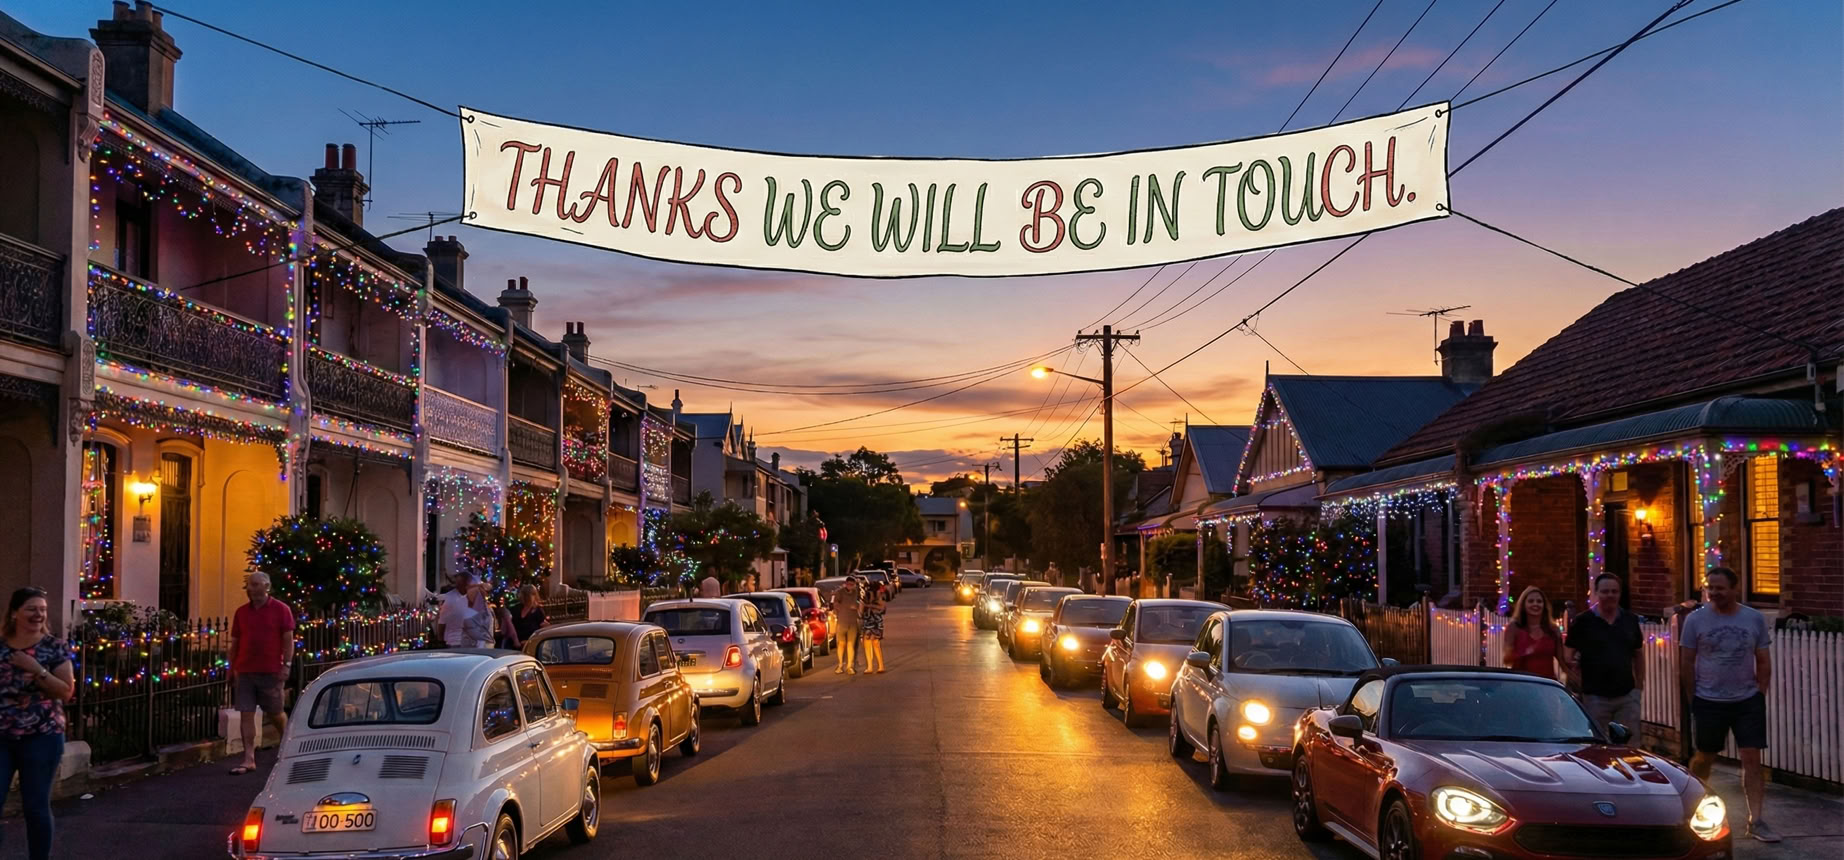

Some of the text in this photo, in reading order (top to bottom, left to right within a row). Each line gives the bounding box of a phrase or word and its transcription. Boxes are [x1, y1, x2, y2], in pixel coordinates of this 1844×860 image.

[500, 136, 1416, 254] THANKS WE WILL BE IN TOUCH.
